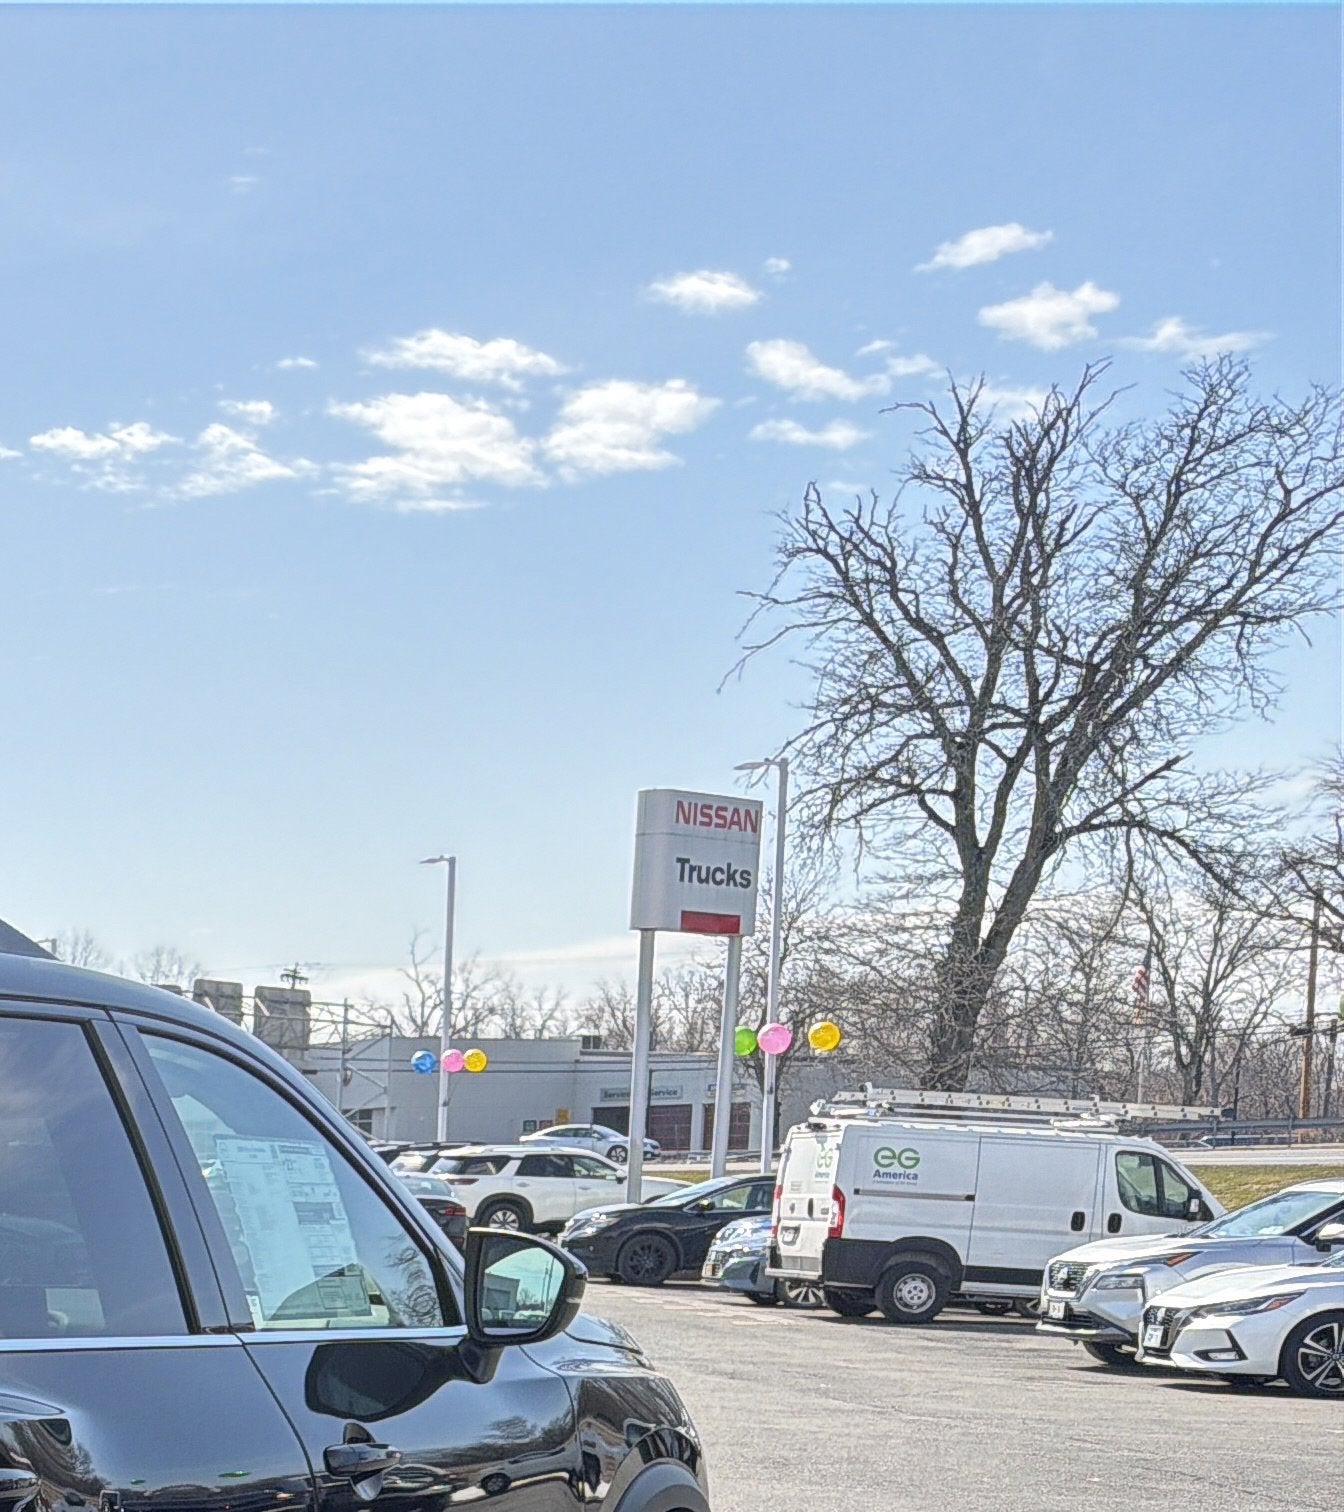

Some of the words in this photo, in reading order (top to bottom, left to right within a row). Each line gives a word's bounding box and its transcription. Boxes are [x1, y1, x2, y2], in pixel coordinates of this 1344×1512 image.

[675, 800, 759, 833] NISSAN
[676, 857, 752, 889] Trucks
[873, 1169, 918, 1180] America
